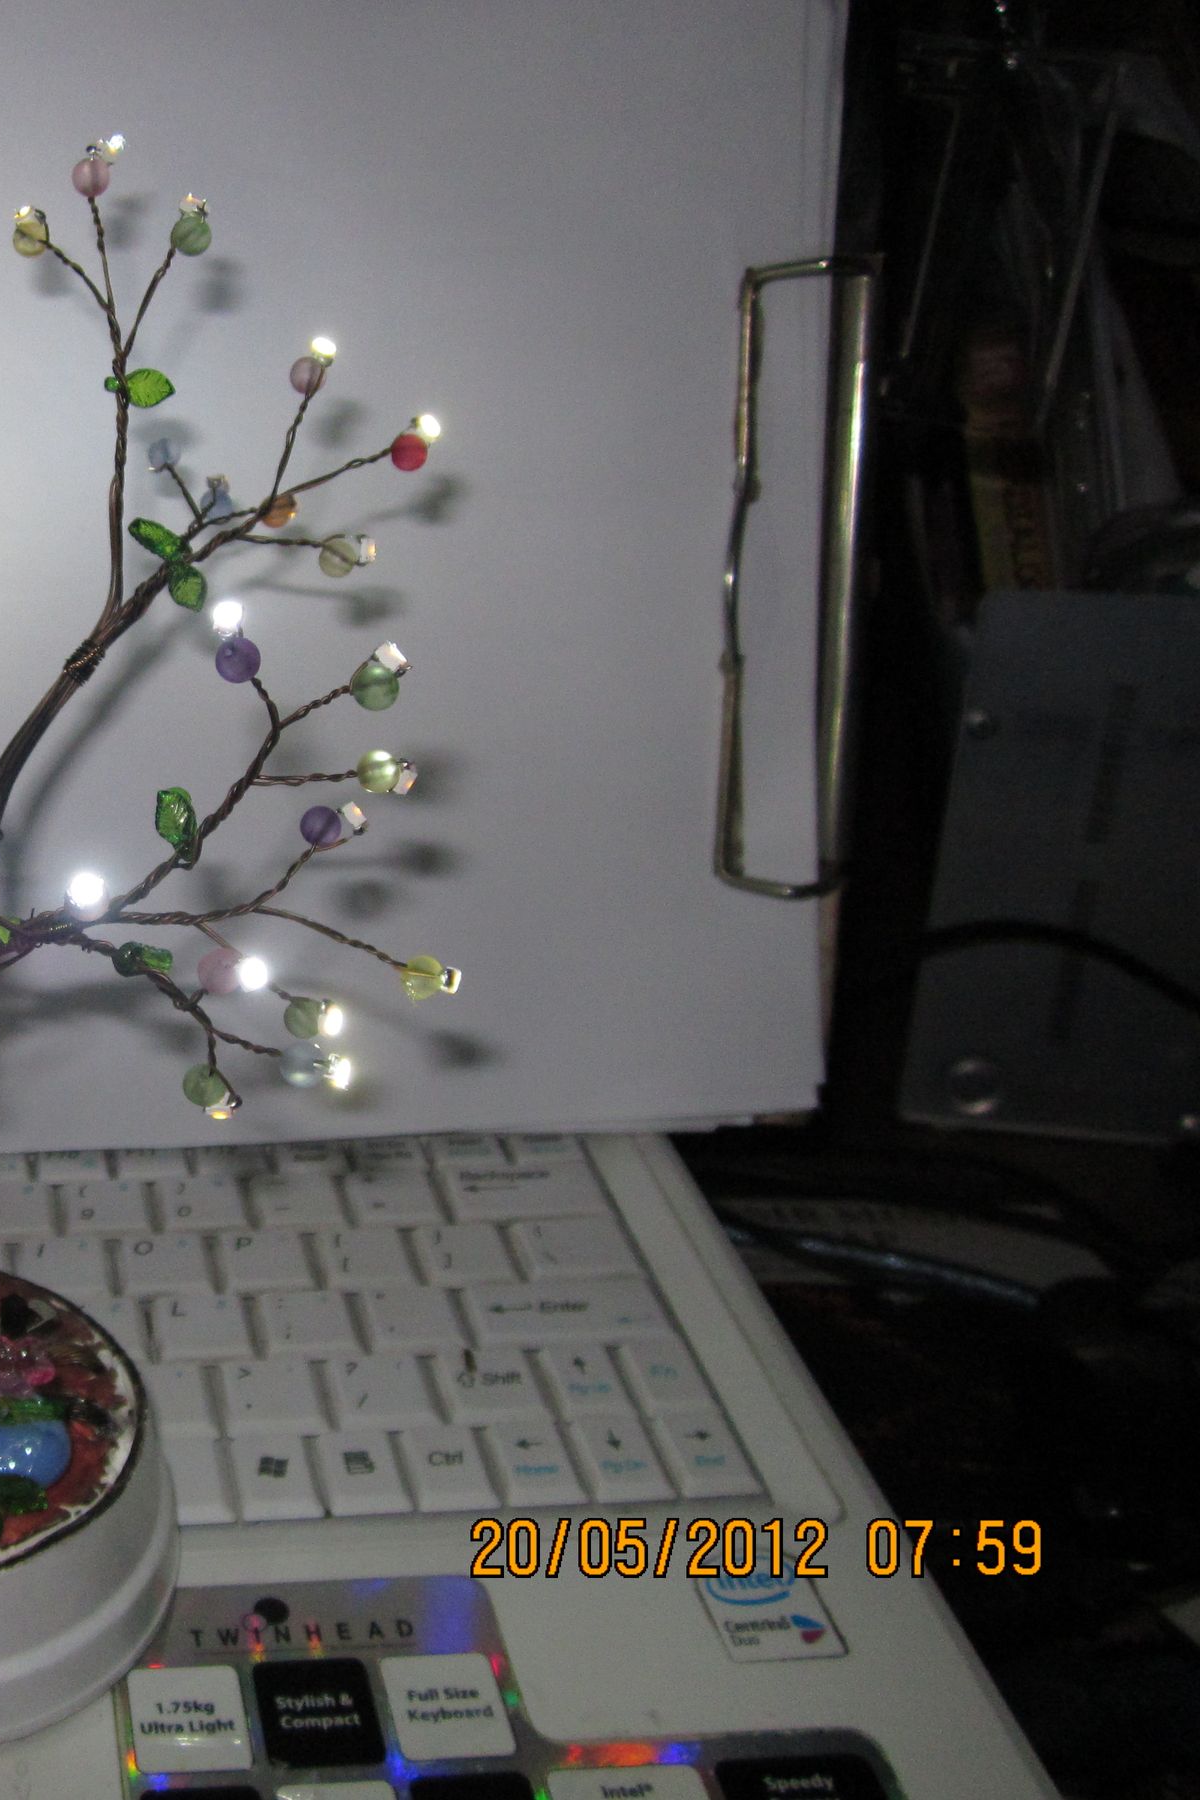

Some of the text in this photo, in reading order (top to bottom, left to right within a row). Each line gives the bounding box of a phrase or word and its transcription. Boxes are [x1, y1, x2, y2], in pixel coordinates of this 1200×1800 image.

[480, 1370, 523, 1387] Shift
[427, 1450, 465, 1467] Ctrl
[190, 1618, 414, 1648] TWINHEAD
[407, 1686, 480, 1702] Full Size
[155, 1699, 216, 1716] 1.75kg
[275, 1694, 337, 1712] Stylish
[280, 1712, 361, 1730] Compact
[407, 1704, 494, 1723] Keyboard
[139, 1718, 236, 1735] Ultra Light
[763, 1775, 834, 1792] Speedy
